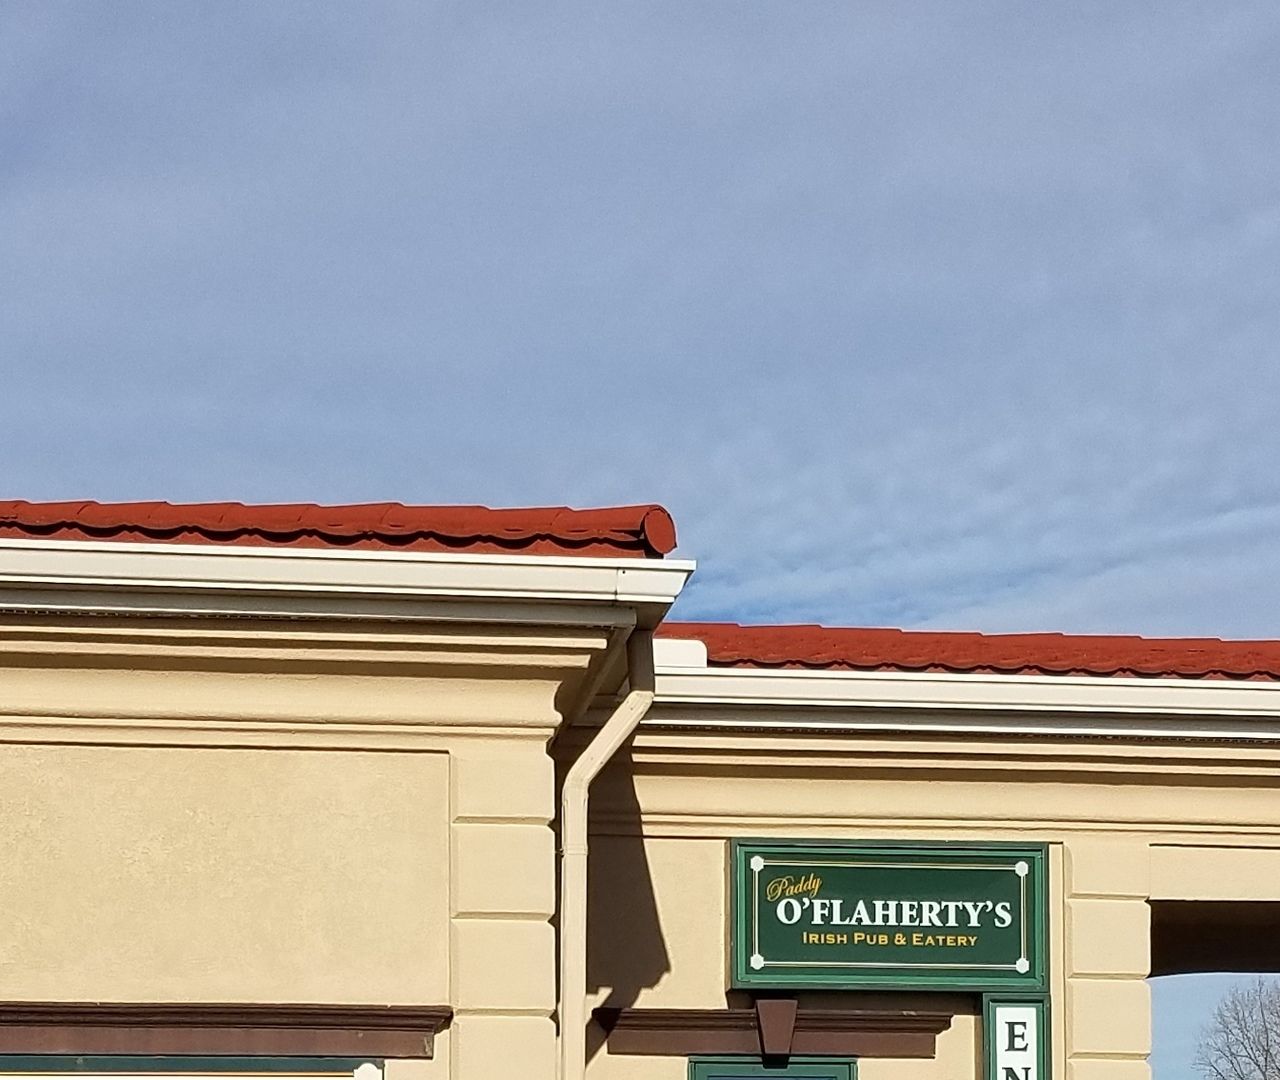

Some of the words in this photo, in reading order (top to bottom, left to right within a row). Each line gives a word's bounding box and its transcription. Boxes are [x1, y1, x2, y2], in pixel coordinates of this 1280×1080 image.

[766, 873, 822, 901] Paddy
[775, 897, 1012, 928] O'FLAHERTY'S
[803, 931, 848, 945] IRISH
[853, 932, 889, 945] PUB
[894, 933, 907, 945] &
[912, 933, 978, 947] EATERY
